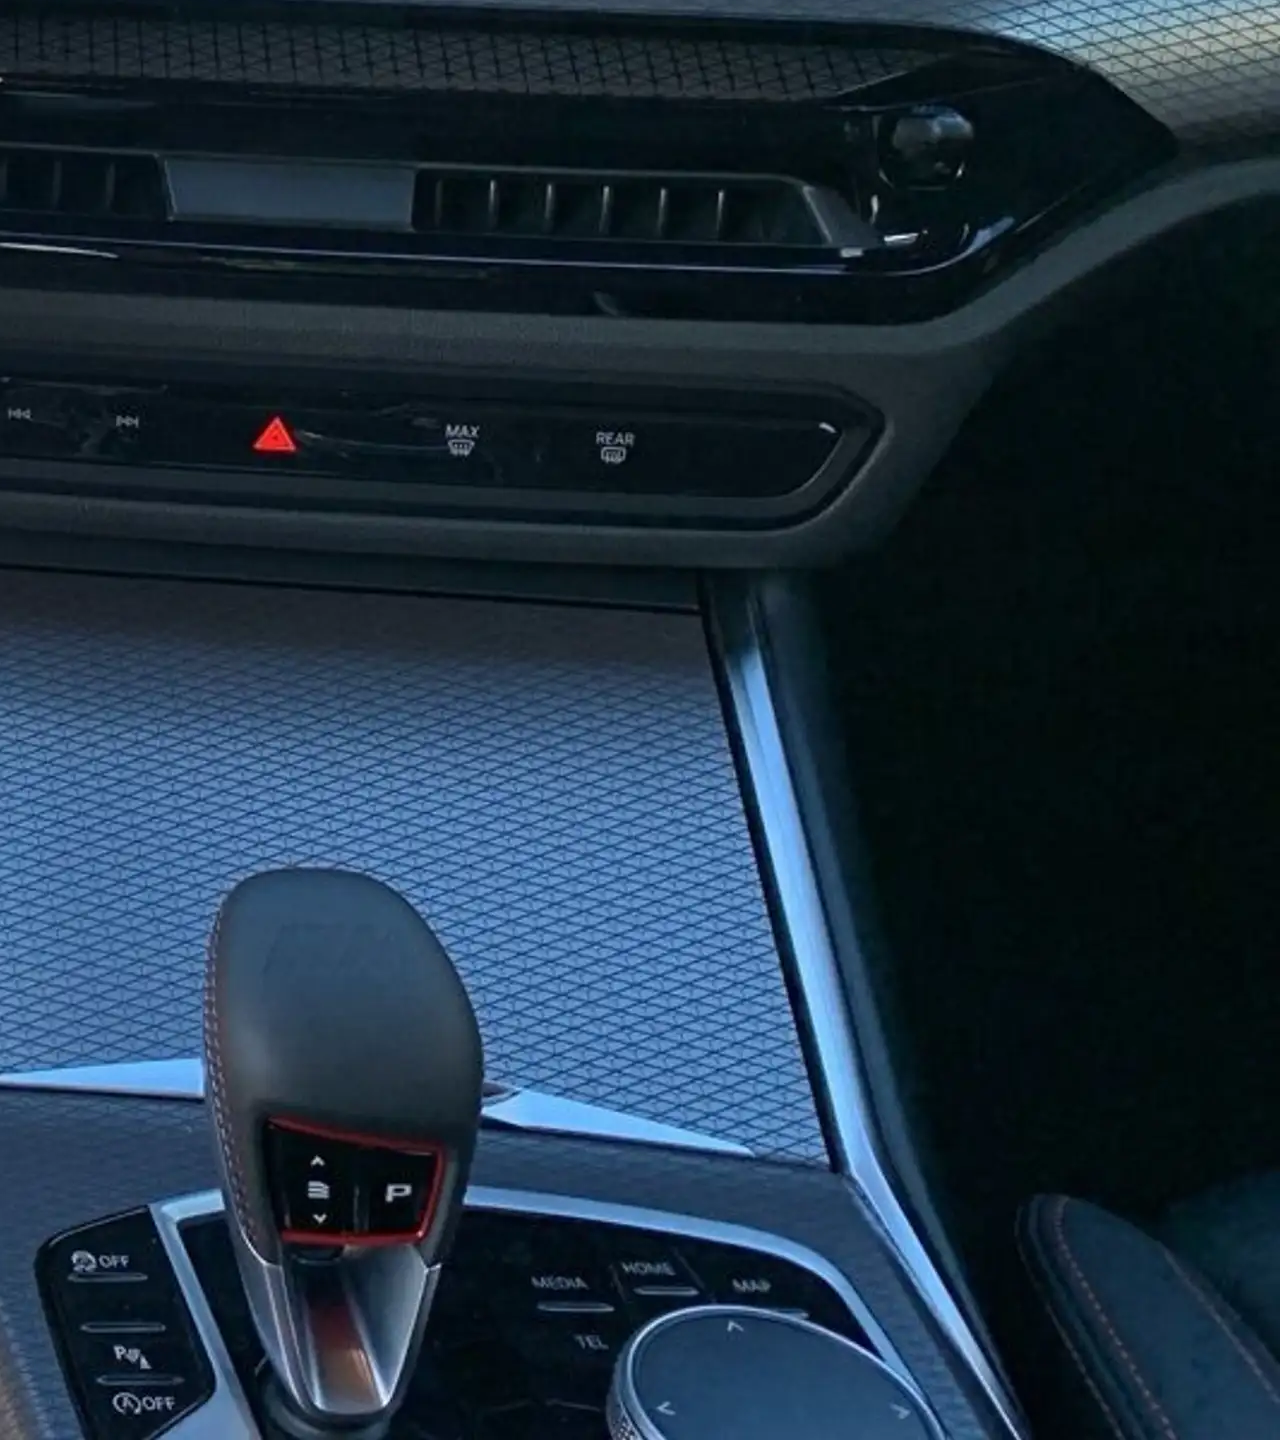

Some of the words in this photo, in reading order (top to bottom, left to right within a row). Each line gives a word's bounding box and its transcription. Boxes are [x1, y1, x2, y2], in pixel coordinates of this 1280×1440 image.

[445, 424, 480, 438] MAX
[596, 432, 634, 446] REAR
[385, 1183, 412, 1203] P
[98, 1255, 130, 1269] OFF
[622, 1261, 676, 1276] HOME
[531, 1276, 588, 1290] MEDIA
[732, 1278, 772, 1293] MAP
[573, 1335, 609, 1350] TEL
[142, 1396, 175, 1410] OFF
